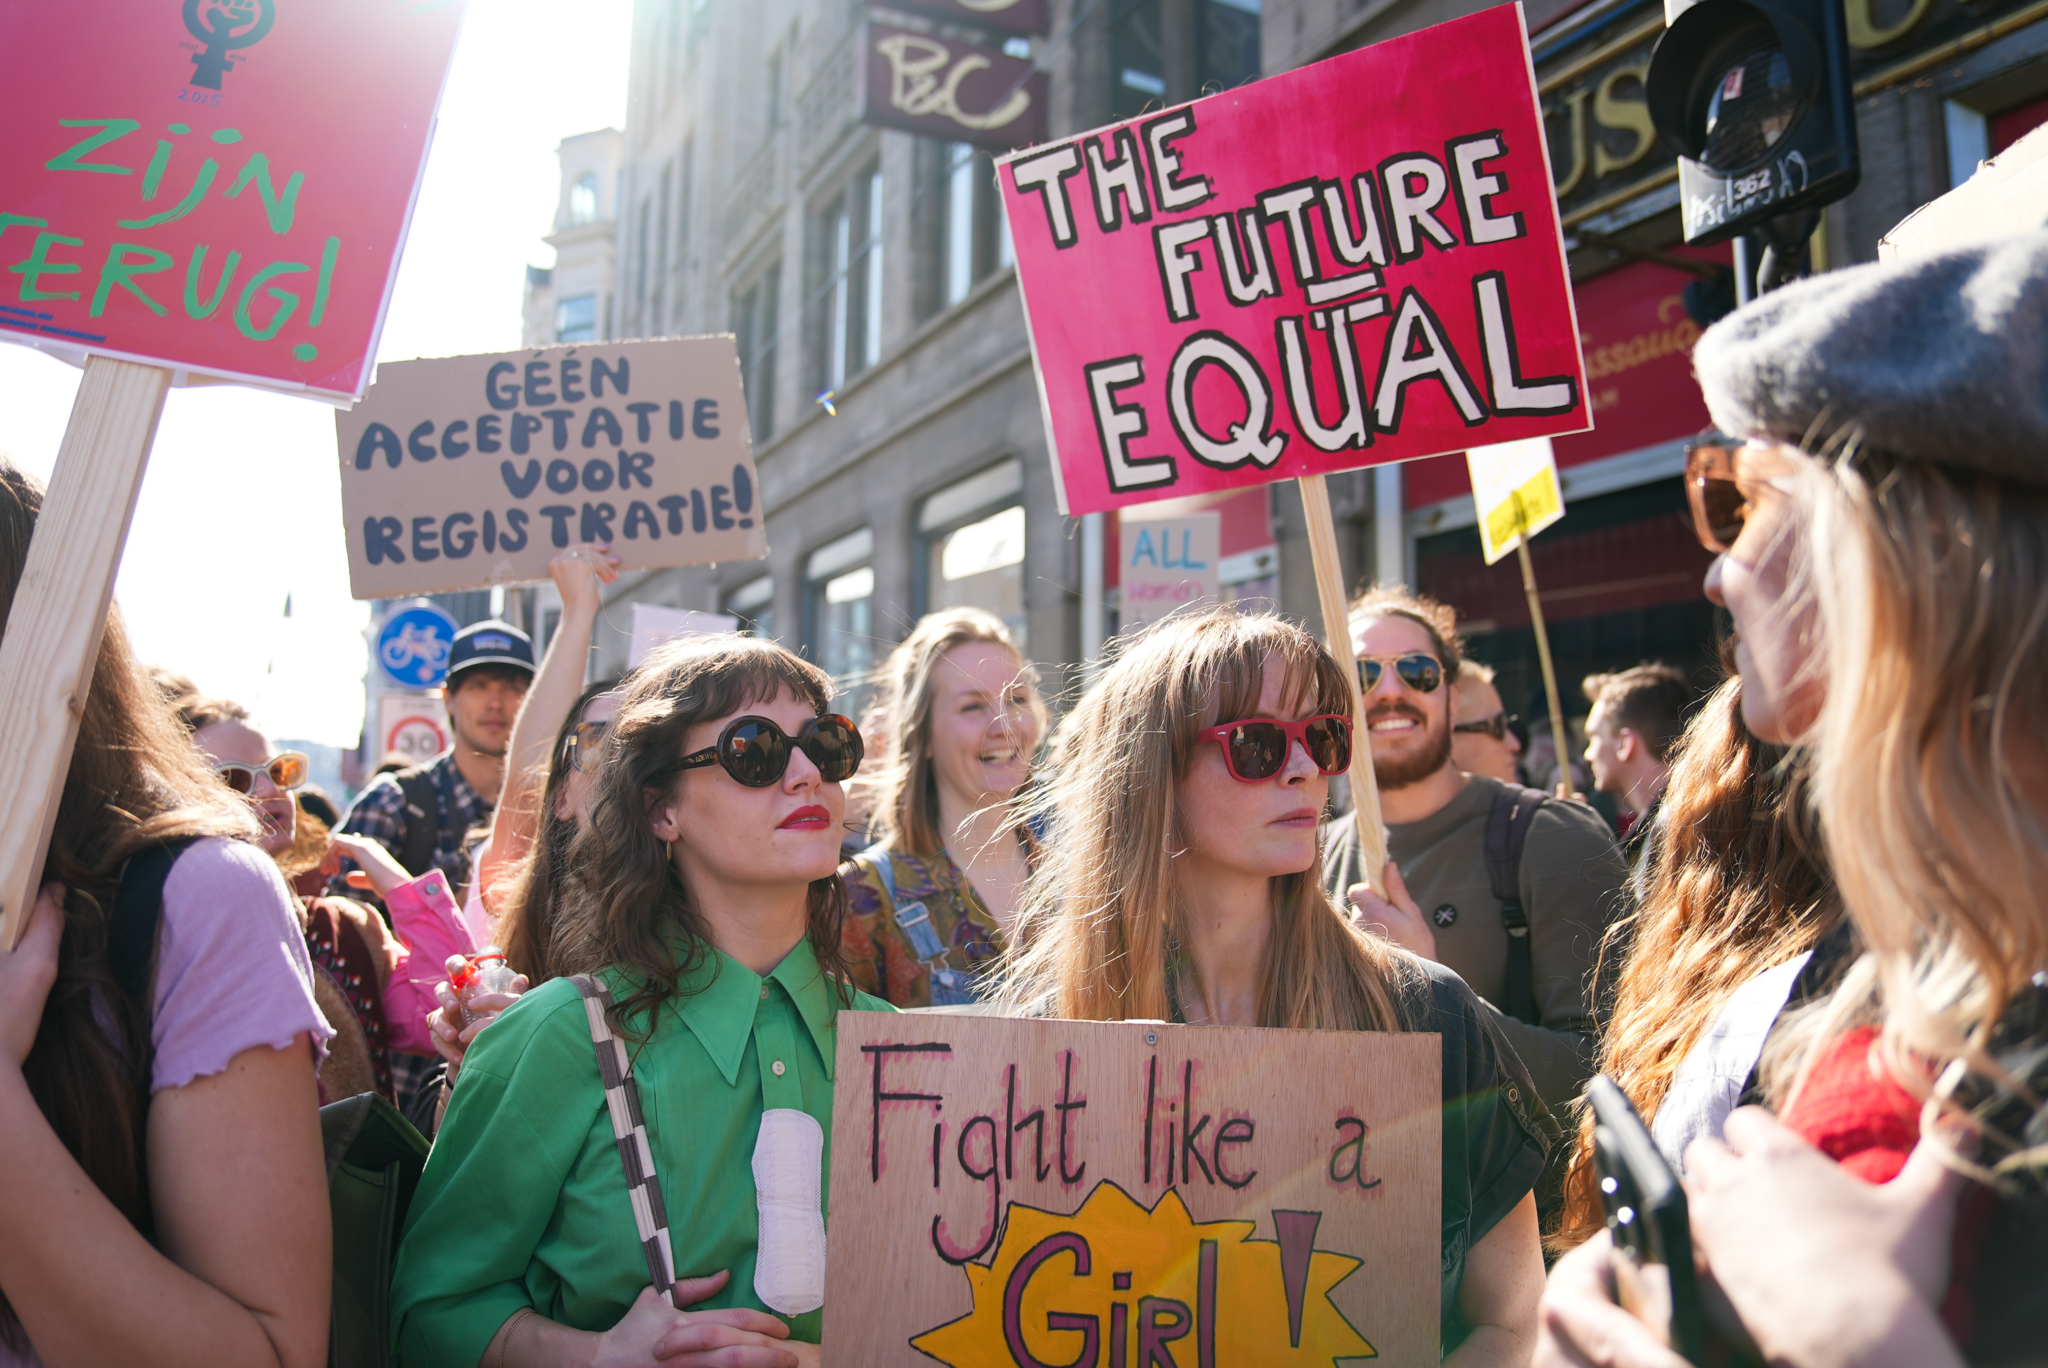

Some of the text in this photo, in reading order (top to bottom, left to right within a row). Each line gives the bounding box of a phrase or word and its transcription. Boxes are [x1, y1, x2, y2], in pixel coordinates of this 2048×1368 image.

[178, 87, 226, 107] 2025
[1010, 105, 1217, 248] THE
[1733, 168, 1771, 200] 362
[485, 350, 630, 410] GÉÉN
[1084, 270, 1579, 494] EQUAL
[355, 398, 721, 471] ACCEPTATIE
[500, 449, 655, 499] VOOR
[363, 464, 755, 566] REGISTRATIE!
[1131, 528, 1207, 570] ALL
[695, 752, 713, 763] LOEWE
[861, 1042, 1382, 1264] Fight like a
